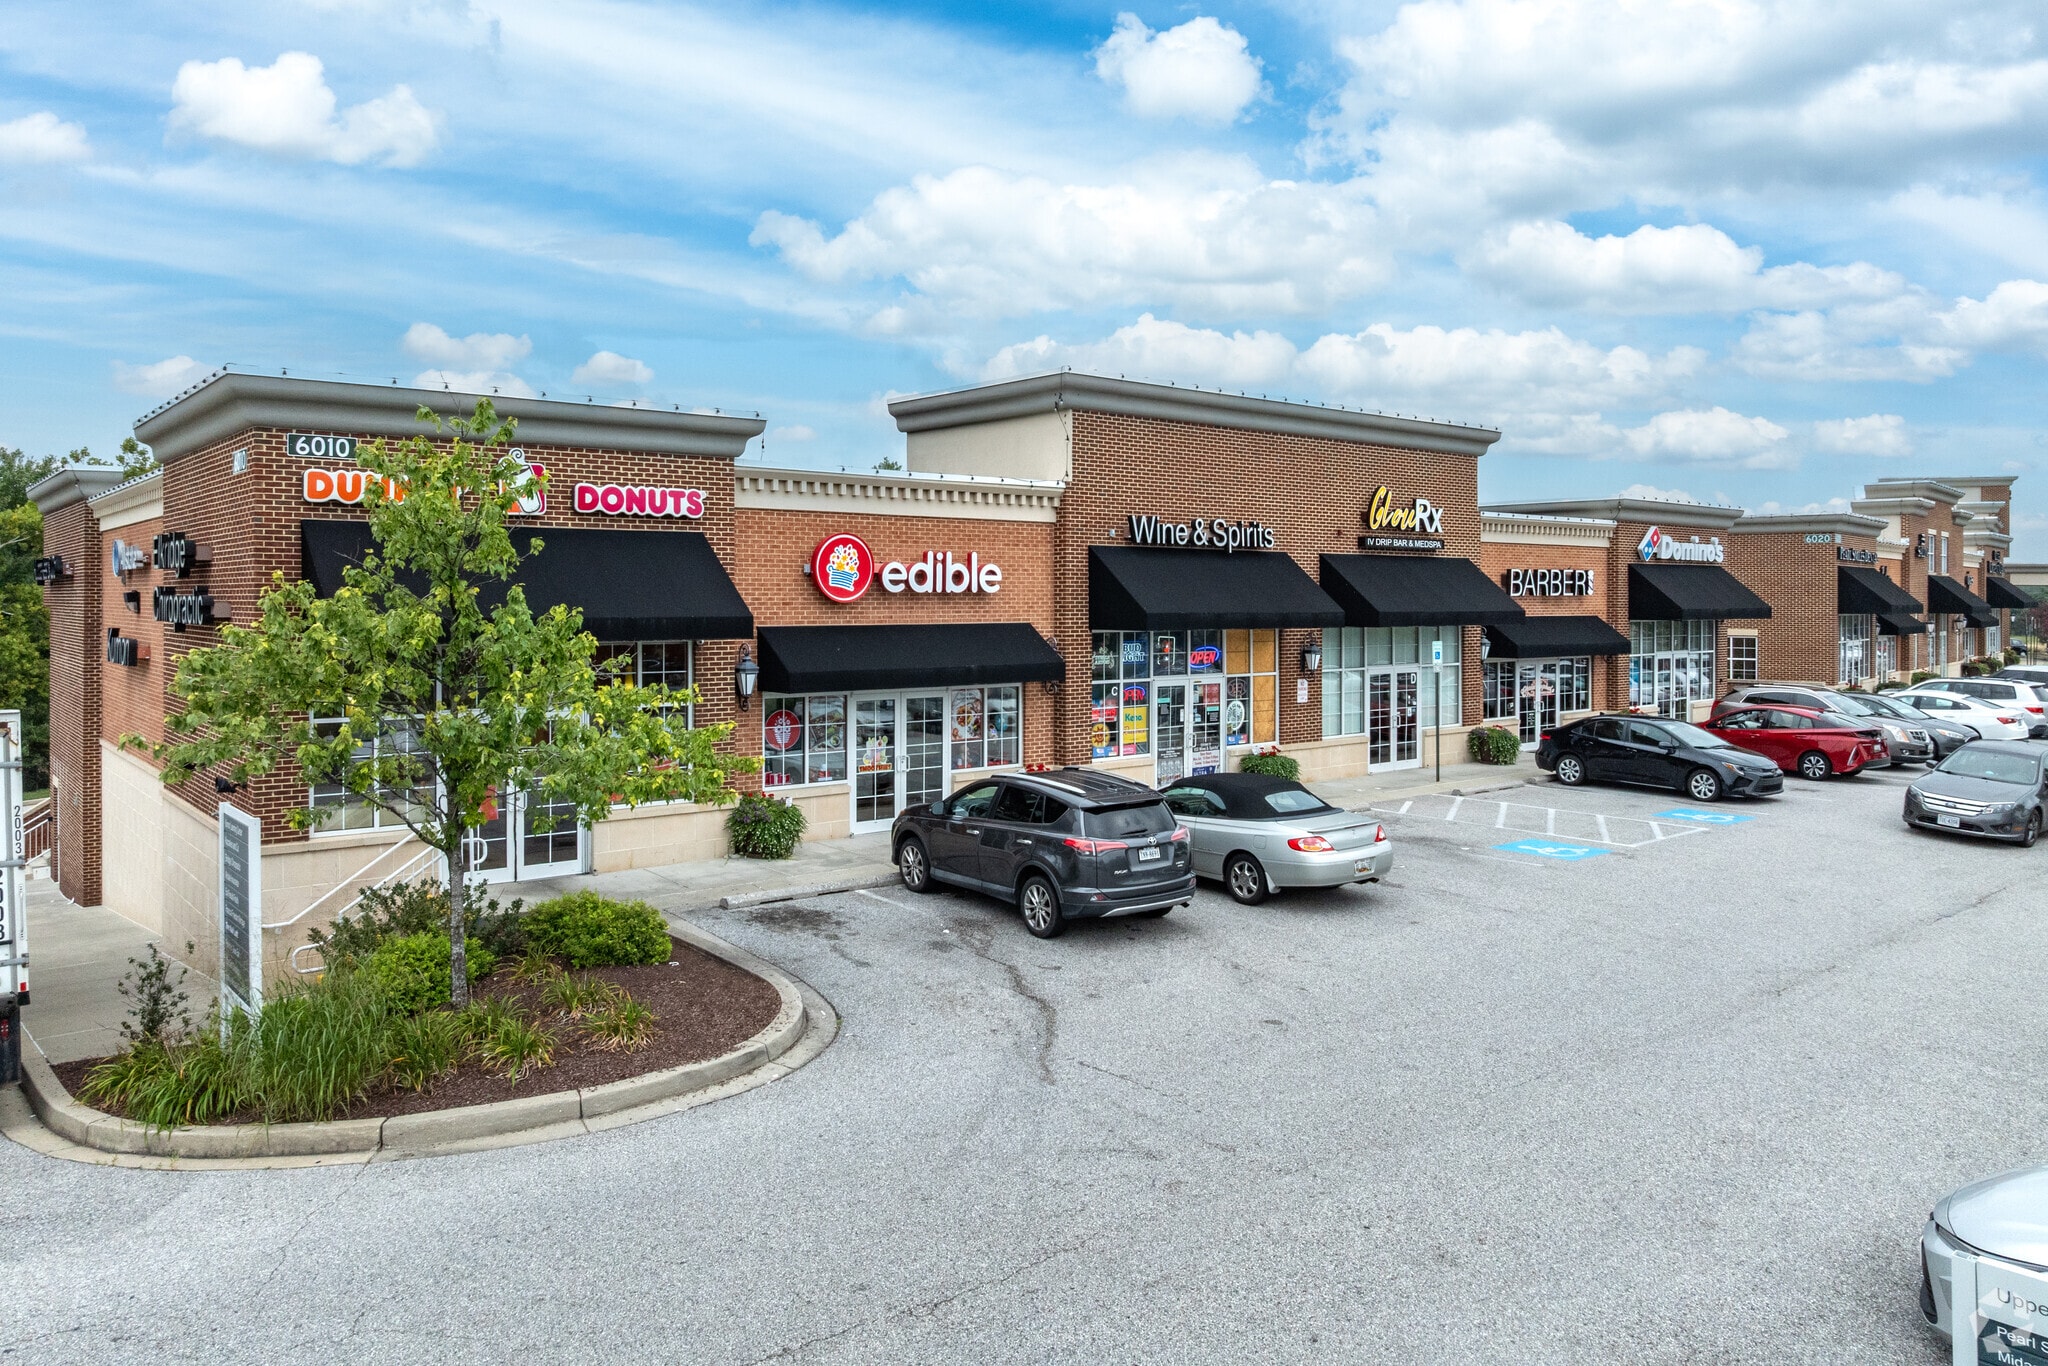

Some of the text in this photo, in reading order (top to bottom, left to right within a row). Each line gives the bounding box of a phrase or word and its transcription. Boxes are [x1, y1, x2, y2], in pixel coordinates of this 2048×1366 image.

[296, 436, 350, 458] 6010
[577, 485, 703, 516] DONUTS
[1131, 515, 1275, 553] Wine & Spirits
[1367, 538, 1442, 549] IV DRIP BAR & MEDSPA
[1806, 534, 1830, 543] 6020
[153, 532, 186, 579] Elkridge
[1660, 535, 1724, 563] Domino's
[881, 550, 1003, 593] edible
[1510, 568, 1587, 597] BARBER
[153, 585, 204, 632] Chiropractic
[1190, 650, 1216, 664] OPEN
[1111, 686, 1118, 696] C
[1410, 673, 1417, 684] D
[1125, 713, 1143, 722] Keno
[14, 805, 23, 854] 2003
[1996, 1325, 2036, 1349] Pearl
